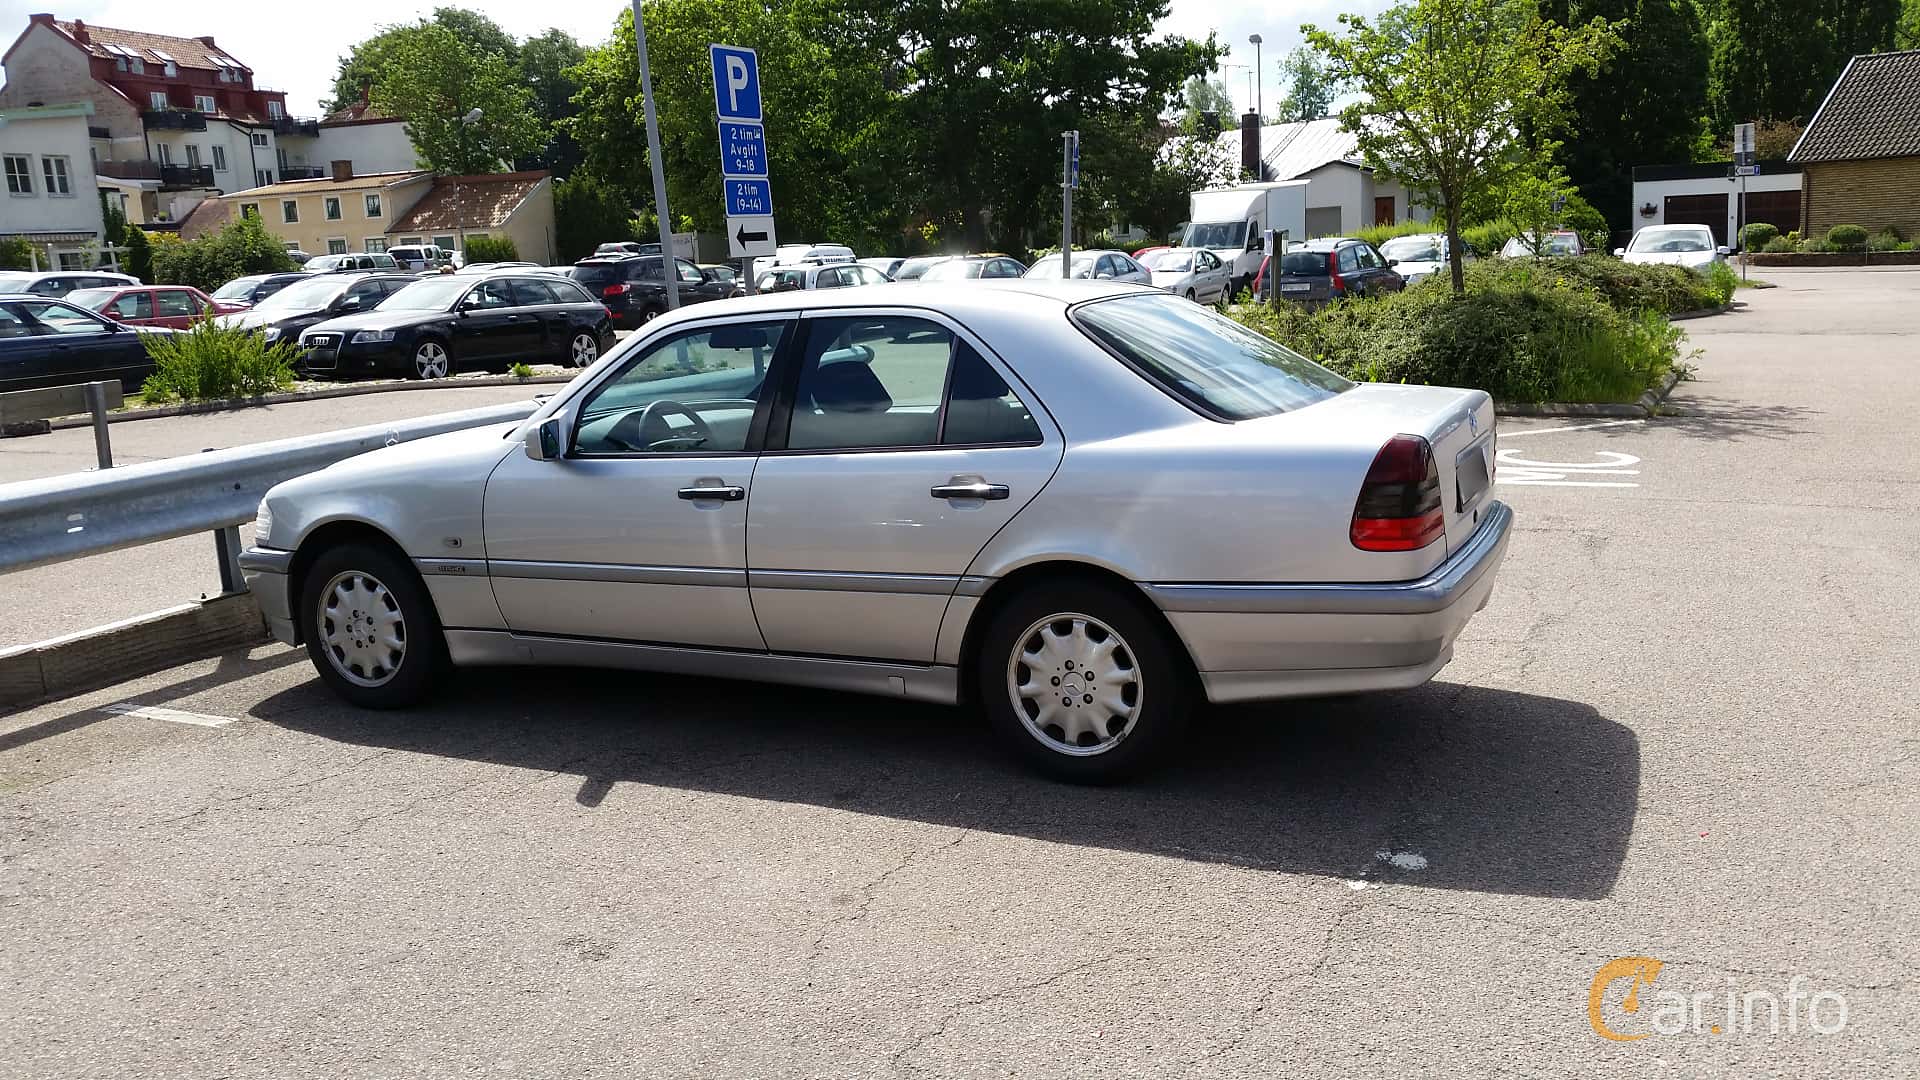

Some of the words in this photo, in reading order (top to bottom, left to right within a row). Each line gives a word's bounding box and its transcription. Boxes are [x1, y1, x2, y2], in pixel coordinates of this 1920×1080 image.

[725, 55, 748, 112] P
[731, 127, 738, 140] 2
[740, 127, 754, 141] tim
[730, 143, 758, 159] Avgift
[736, 158, 755, 172] 9-18
[737, 197, 762, 212] (9-14)
